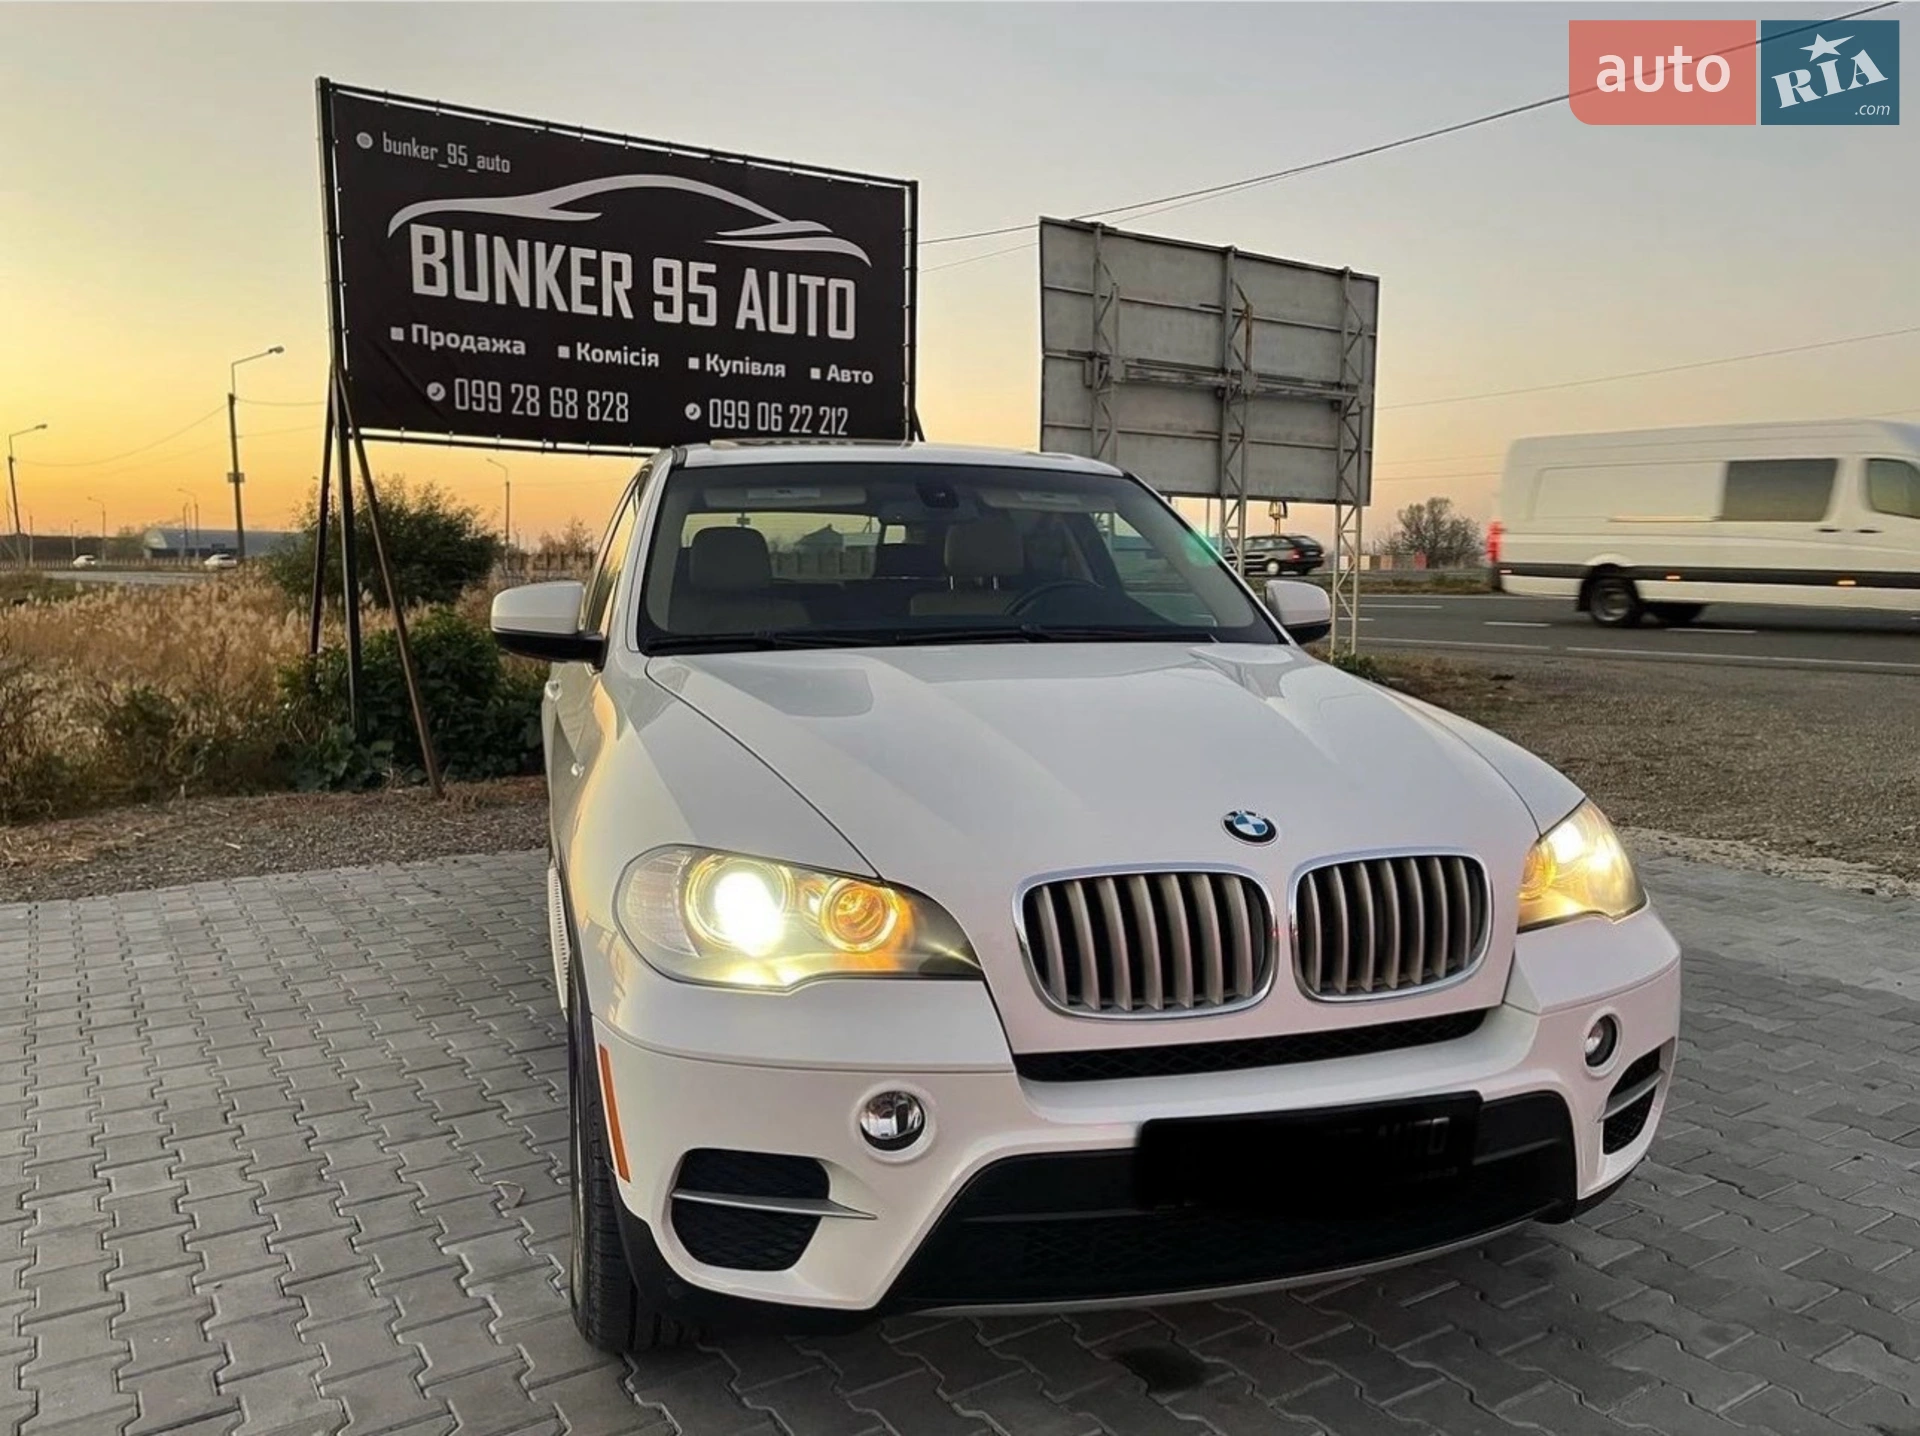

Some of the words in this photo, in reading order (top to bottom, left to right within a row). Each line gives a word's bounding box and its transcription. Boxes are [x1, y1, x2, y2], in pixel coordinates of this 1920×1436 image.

[382, 130, 511, 173] bunker_95_auto
[410, 223, 634, 319] BUNKER
[652, 256, 717, 327] 95
[735, 267, 856, 340] AUTO
[411, 323, 526, 355] Продажа
[576, 341, 660, 368] Комісія
[705, 353, 786, 378] Купівля
[826, 364, 874, 384] Авто
[454, 378, 502, 413] 099
[511, 383, 540, 416] 28
[550, 387, 578, 419] 68
[587, 390, 629, 422] 828
[709, 399, 750, 430] 099
[757, 402, 783, 432] 06
[789, 404, 812, 433] 22
[819, 406, 849, 435] 212
